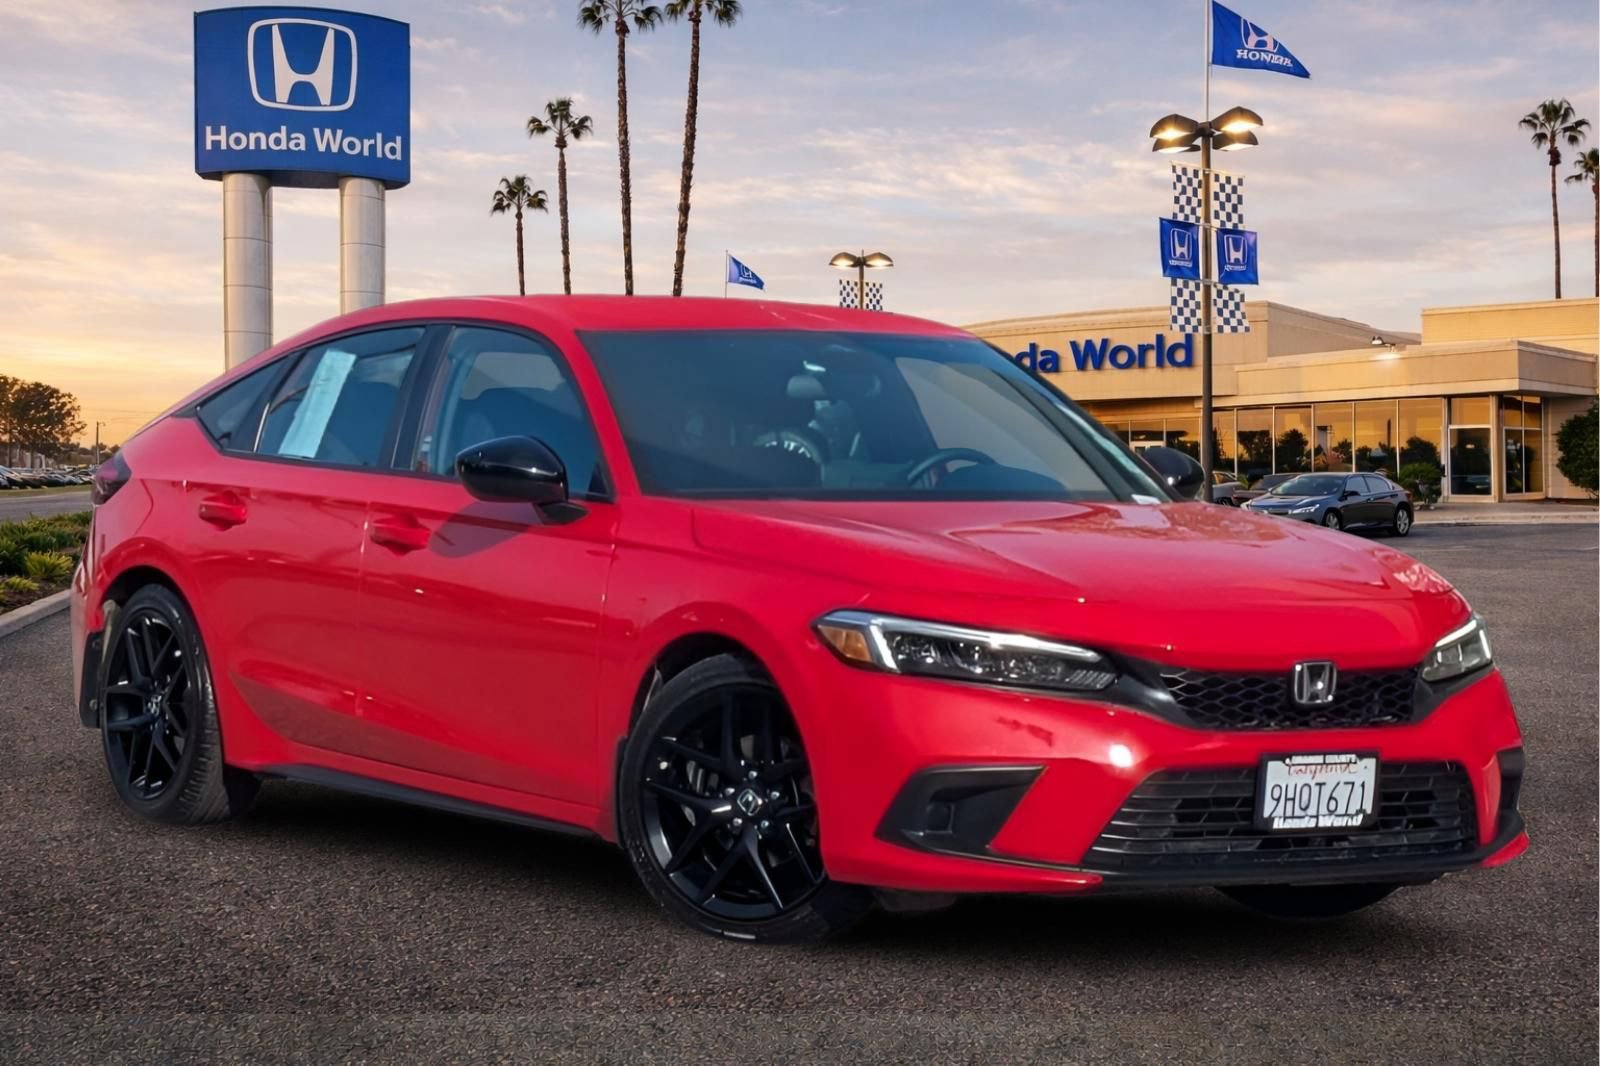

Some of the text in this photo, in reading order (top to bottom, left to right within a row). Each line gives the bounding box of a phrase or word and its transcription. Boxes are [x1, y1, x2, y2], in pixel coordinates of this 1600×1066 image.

[205, 125, 402, 160] Honda World
[1069, 333, 1194, 372] World
